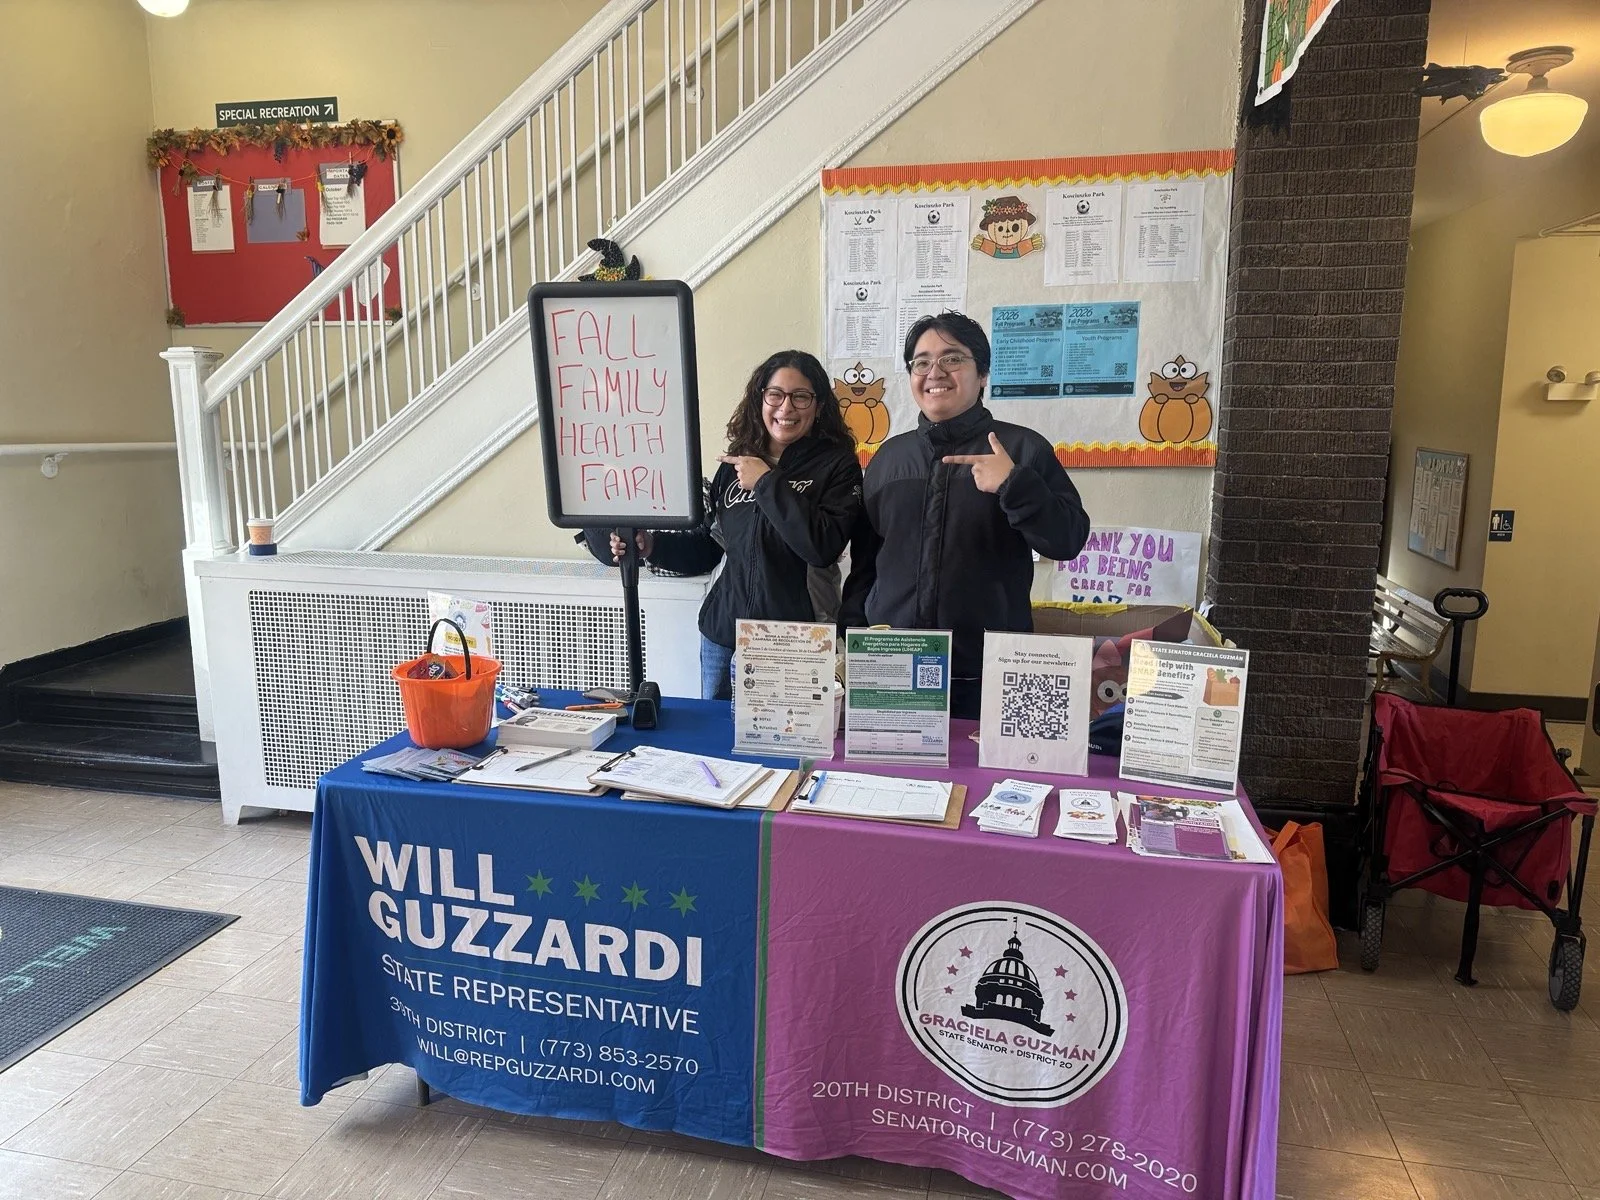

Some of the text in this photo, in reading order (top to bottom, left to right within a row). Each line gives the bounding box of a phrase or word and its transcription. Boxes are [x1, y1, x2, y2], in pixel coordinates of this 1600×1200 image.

[219, 105, 320, 121] SPECIAL RECREATION
[551, 309, 656, 361] FALL
[996, 311, 1019, 320] 2026
[1069, 308, 1093, 318] 2026
[558, 364, 667, 417] FAMILY
[559, 417, 664, 458] HEALTH
[581, 463, 666, 511] FAIR!!
[1058, 555, 1152, 581] FOR BEING
[1083, 532, 1174, 563] ANK YOU
[1127, 583, 1152, 597] FOR
[1168, 648, 1192, 656] SENATOR
[1175, 663, 1194, 671] with
[1157, 670, 1196, 680] Benefits?
[353, 835, 515, 907] WILL
[368, 890, 702, 987] GUZZARDI
[381, 953, 700, 1035] STATE REPRESENTATIVE
[427, 1016, 507, 1048] DISTRICT
[539, 1038, 593, 1063] (773)
[599, 1045, 699, 1075] 853-2570
[919, 1013, 1096, 1062] GRACIELA GUZMÁN
[939, 1029, 1072, 1069] STATE SENATOR DISTRICT 20
[416, 1035, 655, 1095] WILL@REPGUZZARDI.COM
[812, 1081, 870, 1099] 20TH
[877, 1084, 974, 1119] DISTRICT
[1012, 1118, 1074, 1153] (773)
[1081, 1134, 1198, 1194] 278-2020
[871, 1109, 1128, 1191] SENATORGUZMAN.COM
